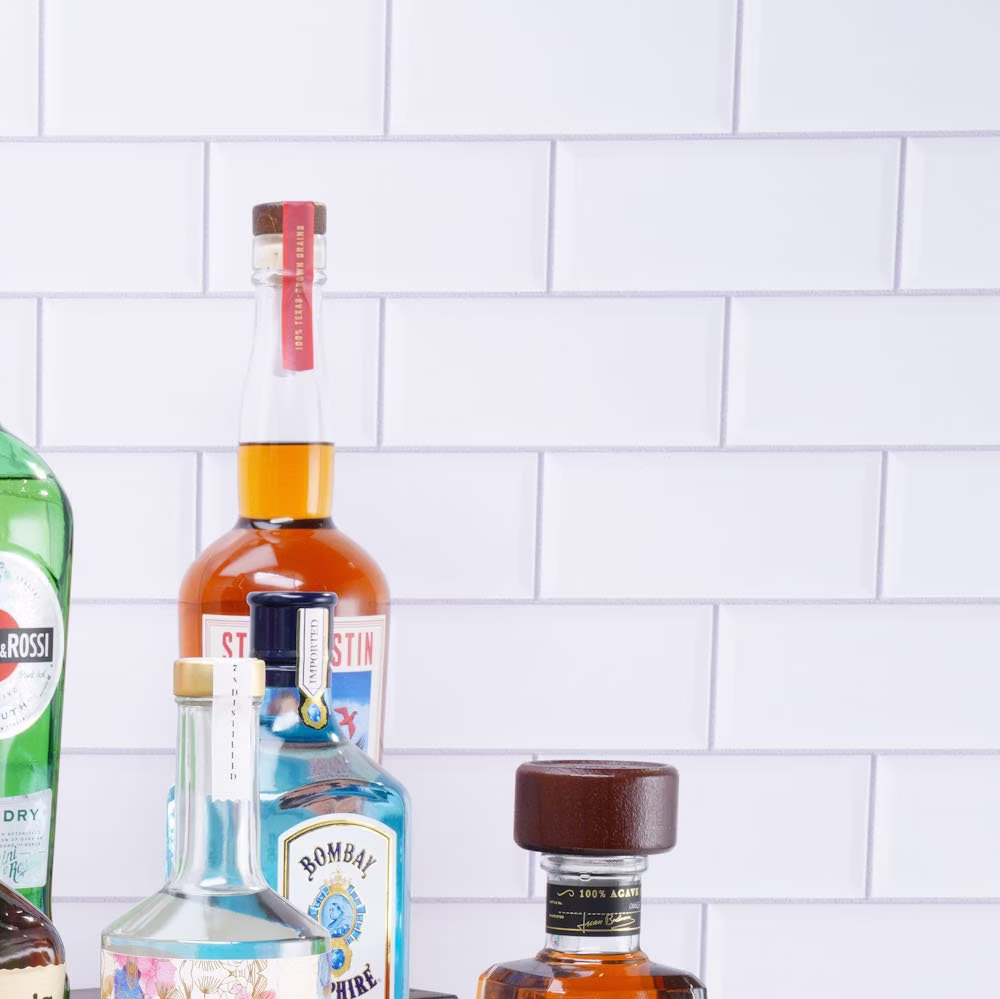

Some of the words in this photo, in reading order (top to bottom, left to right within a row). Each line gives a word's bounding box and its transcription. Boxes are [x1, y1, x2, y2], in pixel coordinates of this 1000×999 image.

[310, 618, 320, 684] IMPORTED
[332, 632, 373, 666] STIN
[3, 809, 39, 822] DRY
[298, 841, 377, 882] BOMBAY
[580, 889, 606, 899] 100%
